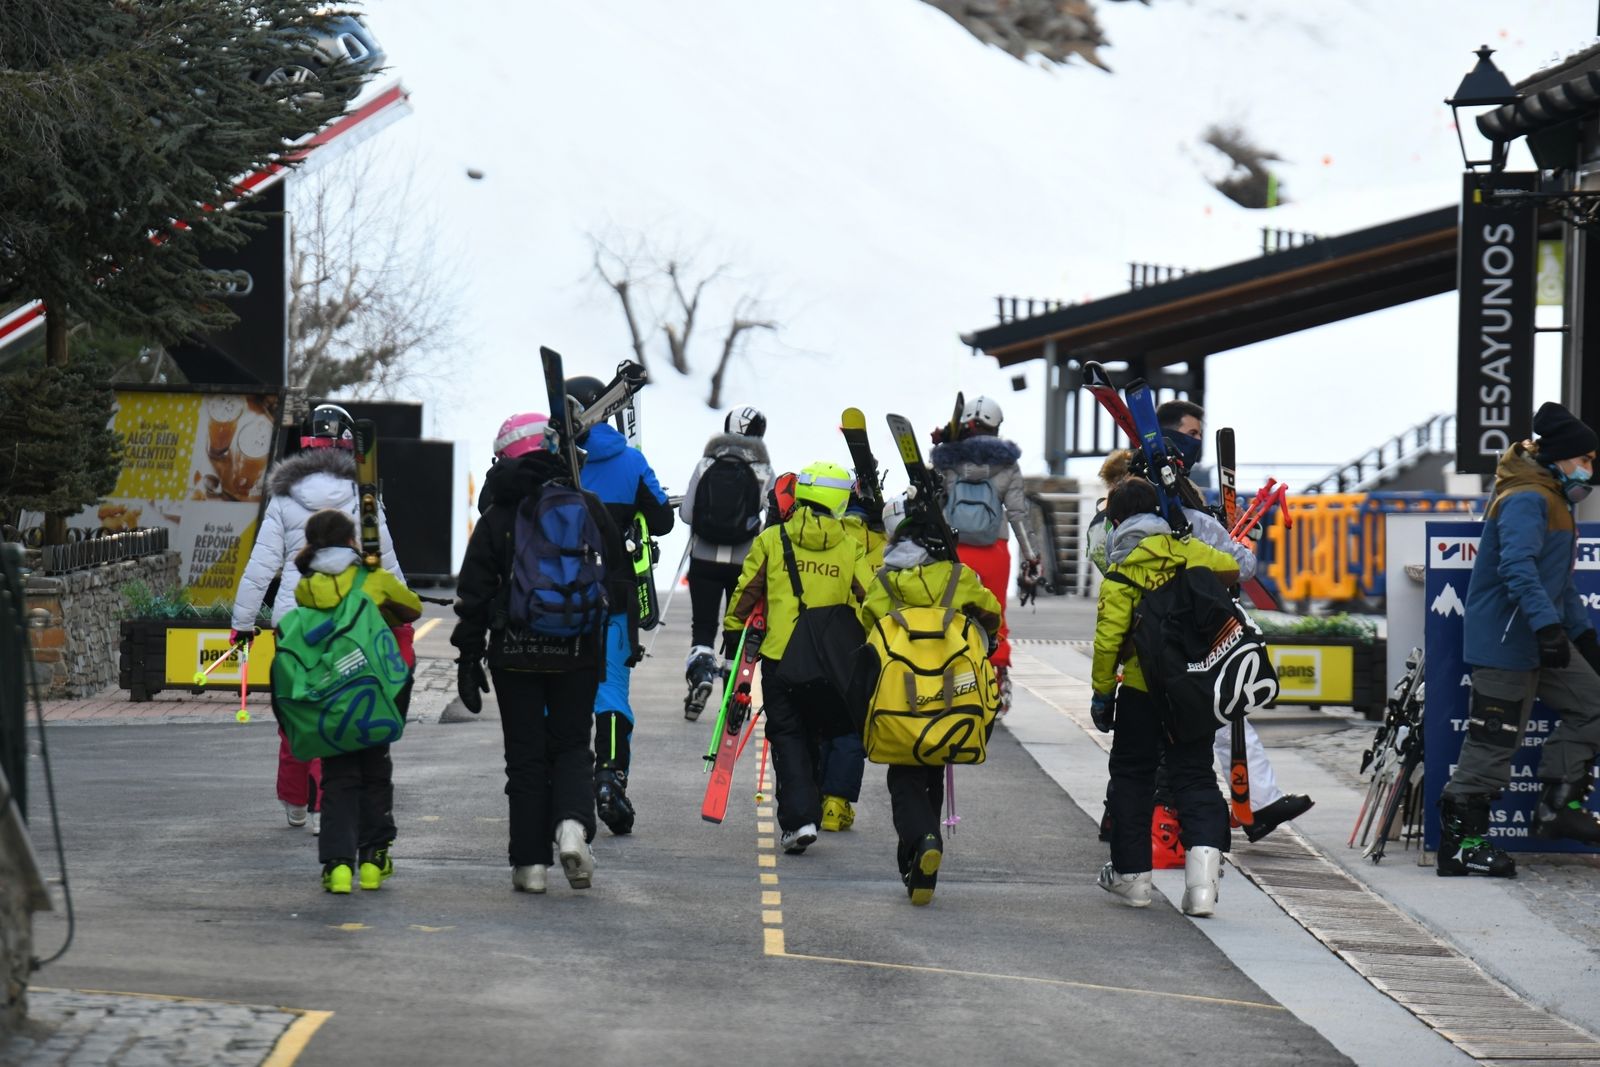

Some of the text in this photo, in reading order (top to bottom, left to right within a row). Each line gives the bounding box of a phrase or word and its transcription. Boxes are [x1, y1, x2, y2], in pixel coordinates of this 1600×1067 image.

[1479, 223, 1515, 456] DESAYUNOS
[127, 432, 180, 446] ALGO BIEN
[124, 446, 177, 460] CALENTITO
[195, 535, 241, 550] REPONER
[192, 549, 238, 563] FUERZAS
[188, 575, 234, 589] BAJANDO
[1187, 624, 1244, 672] BRUBAKER
[1276, 665, 1315, 681] pans
[1525, 720, 1549, 732] DE
[1510, 765, 1533, 777] LA
[1465, 862, 1491, 872] ATOMIC
